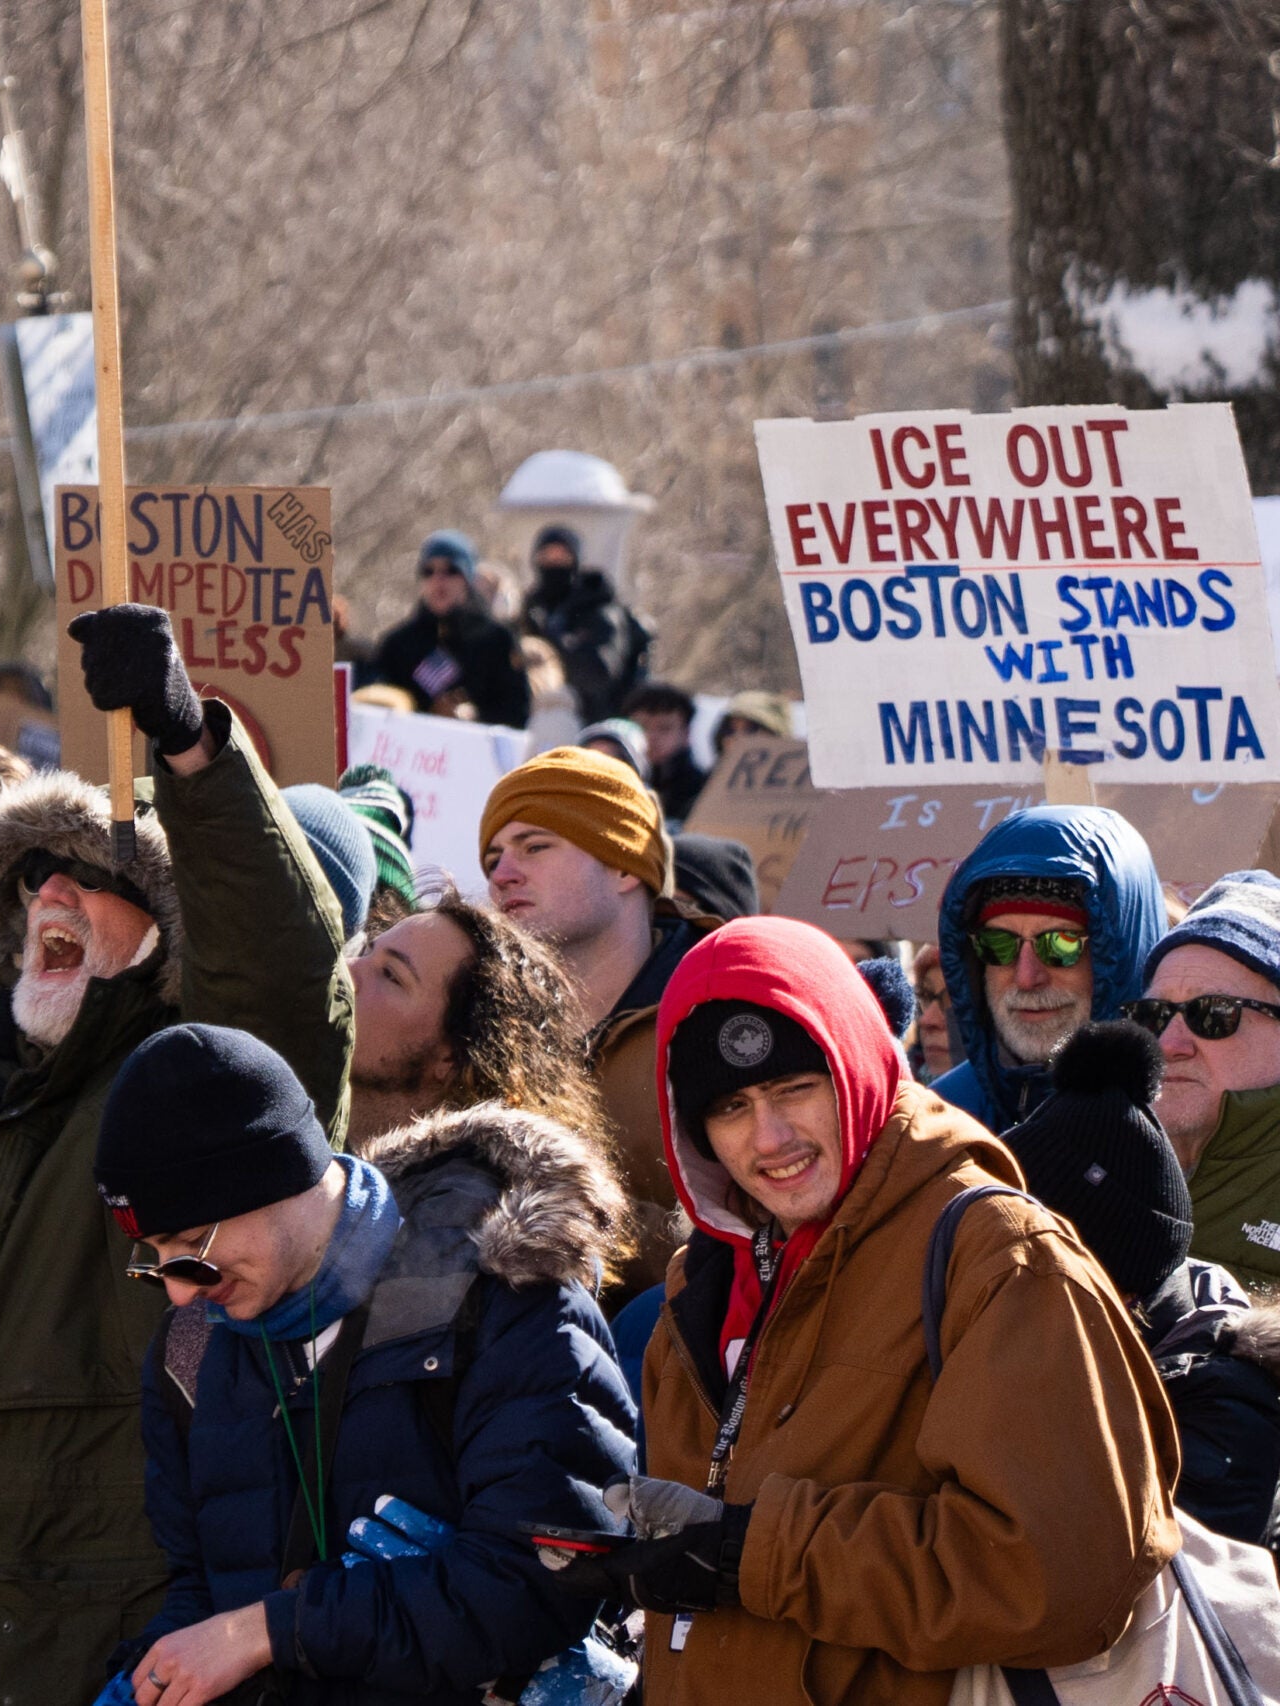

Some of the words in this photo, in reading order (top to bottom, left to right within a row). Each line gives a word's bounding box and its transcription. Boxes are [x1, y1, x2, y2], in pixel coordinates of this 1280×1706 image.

[868, 424, 971, 491] ICE
[1006, 419, 1129, 488] OUT
[61, 490, 264, 563] BSTON
[267, 492, 333, 564] HAS
[785, 495, 1200, 566] EVERYWHERE
[67, 561, 247, 618] DMPED
[799, 564, 1029, 644] BOSTON
[1056, 569, 1237, 633] STANDS
[182, 620, 306, 679] LESS
[984, 634, 1135, 684] WITH
[878, 685, 1267, 766] MINNESOTA
[878, 795, 944, 831] IS
[720, 1393, 747, 1438] Boston
